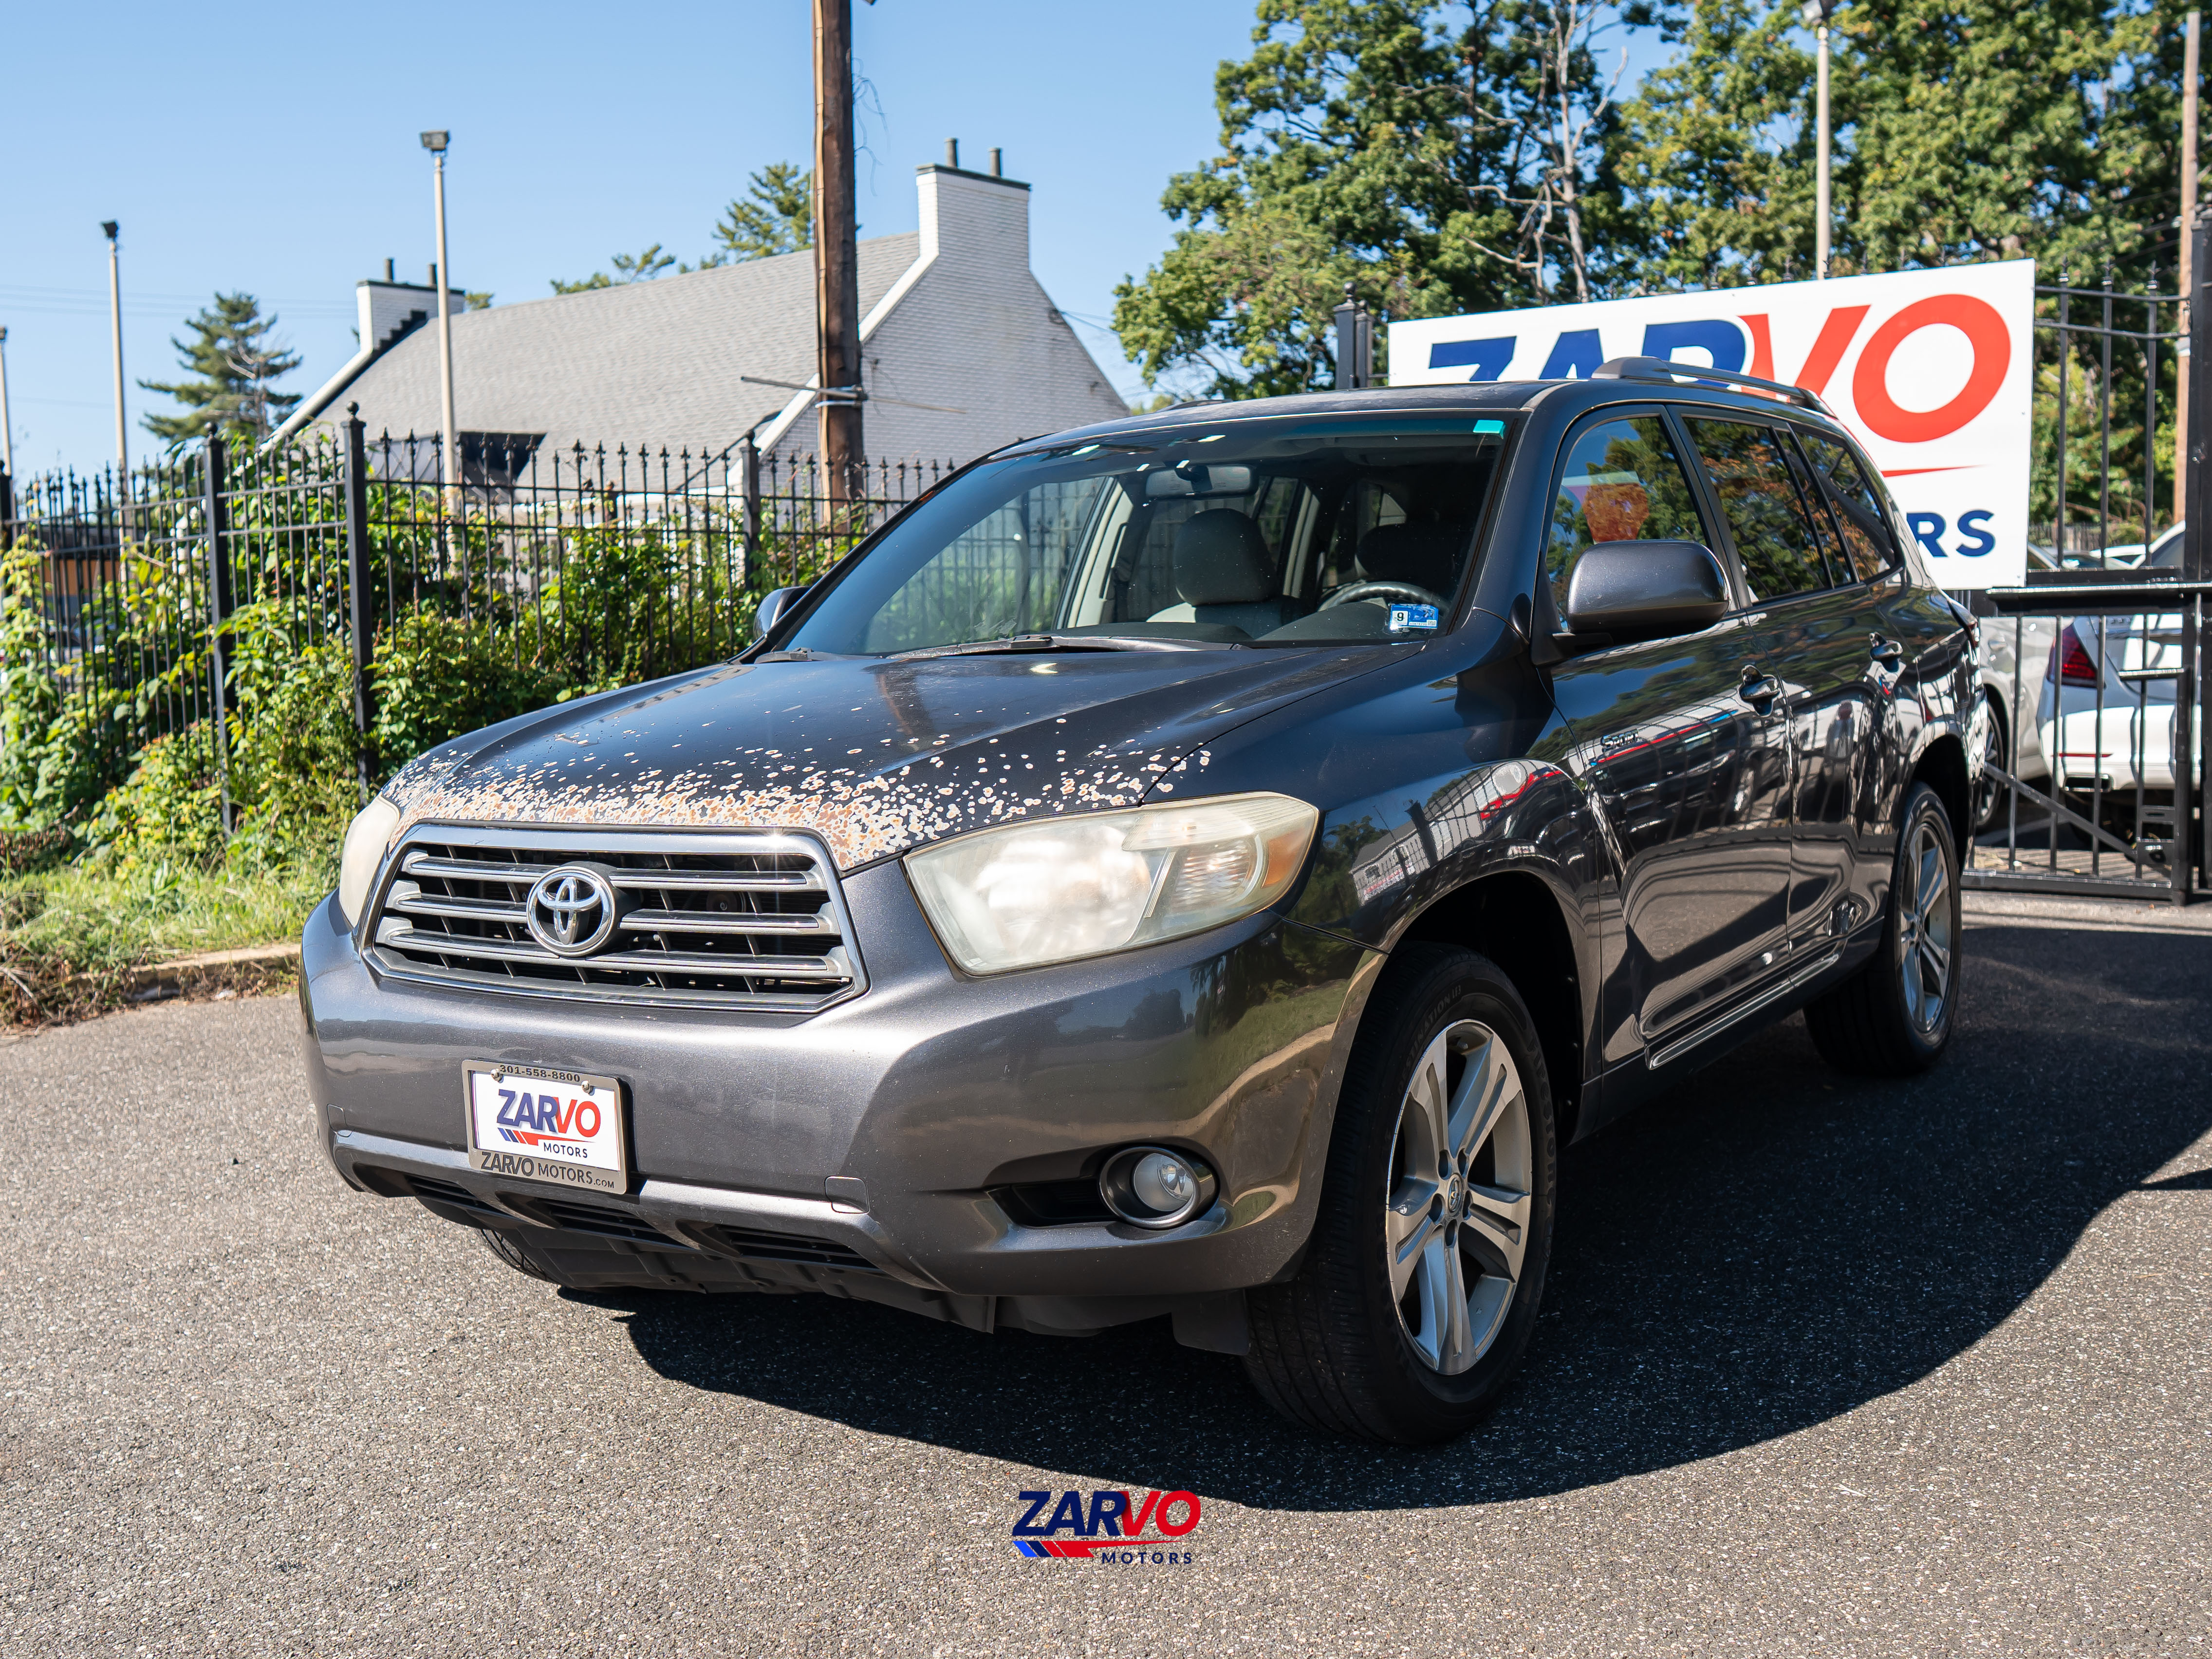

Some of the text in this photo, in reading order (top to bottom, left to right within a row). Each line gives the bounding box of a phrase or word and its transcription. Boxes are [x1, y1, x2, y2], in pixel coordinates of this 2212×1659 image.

[1397, 613, 1404, 621] 9
[500, 1065, 580, 1082] 301-558-8800
[497, 1089, 601, 1137] ZARVO
[543, 1142, 588, 1158] MOTORS
[481, 1152, 534, 1176] ZARVO
